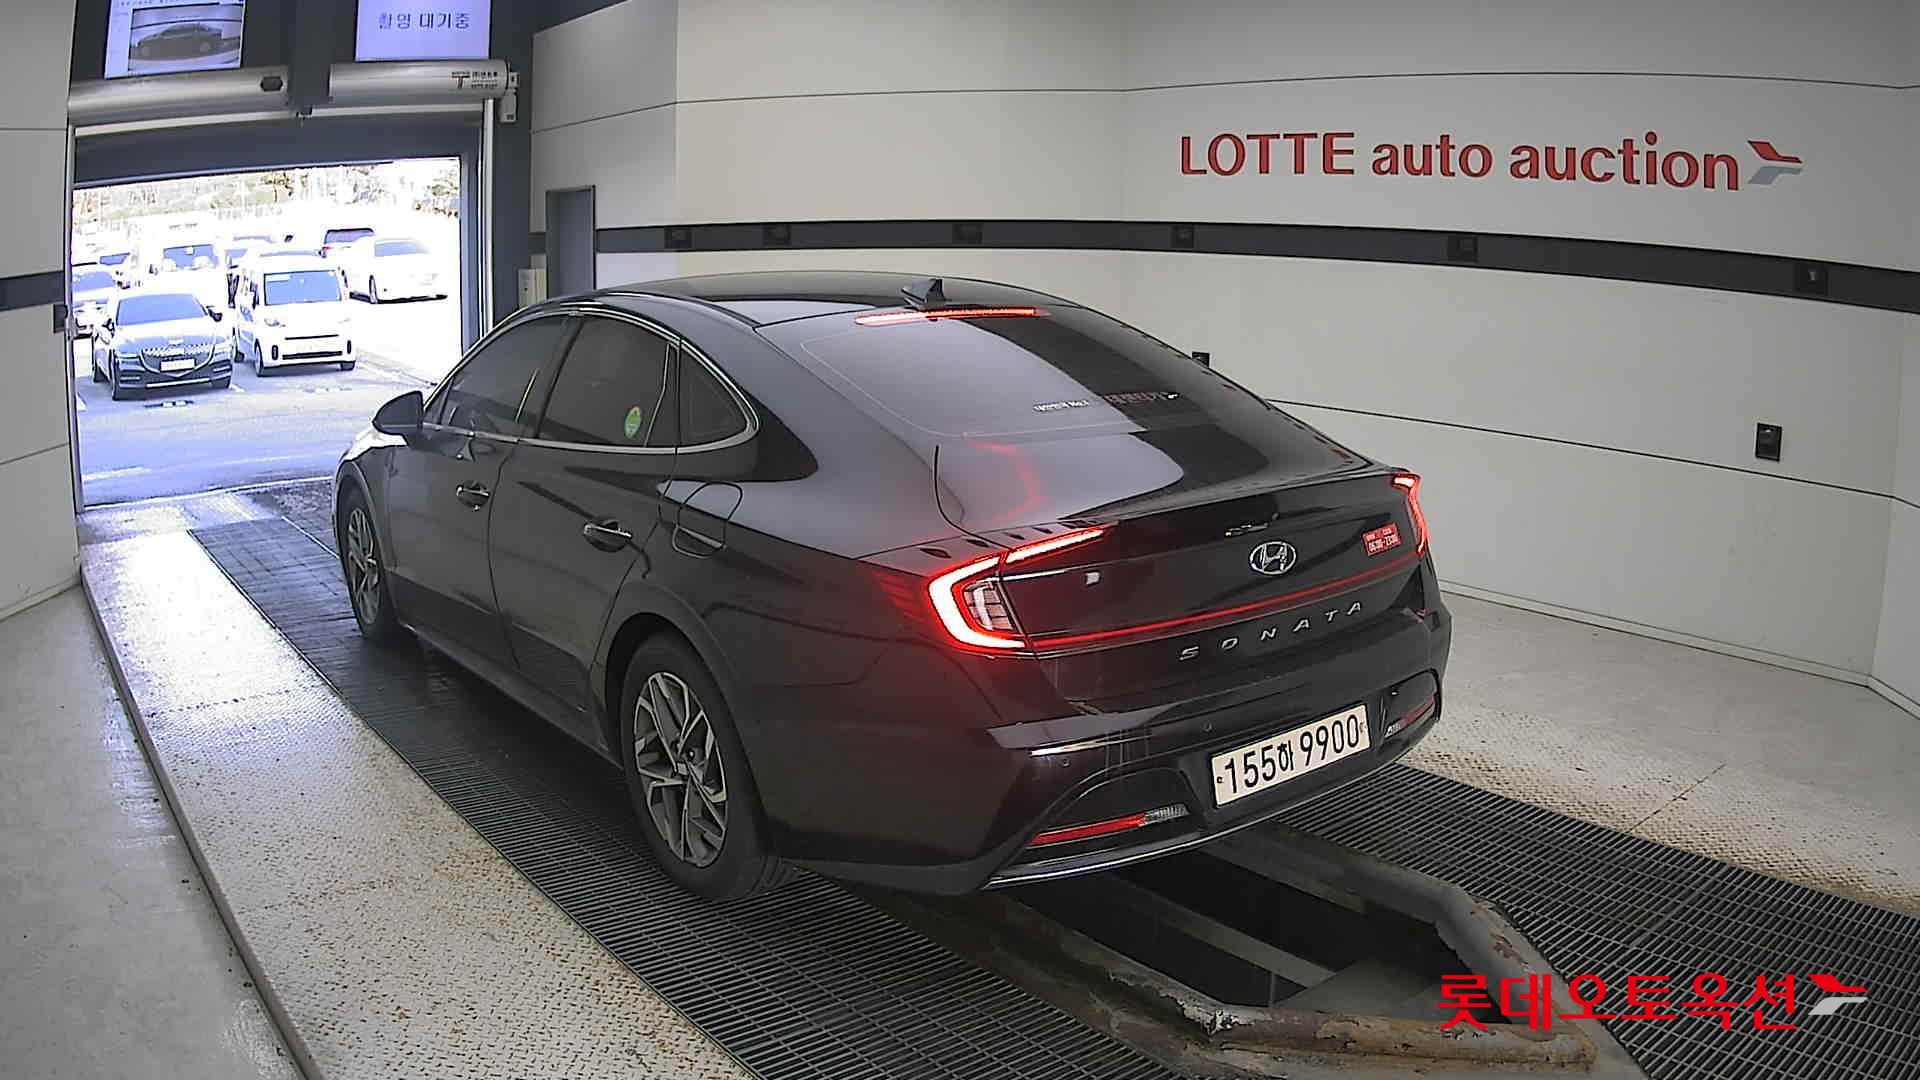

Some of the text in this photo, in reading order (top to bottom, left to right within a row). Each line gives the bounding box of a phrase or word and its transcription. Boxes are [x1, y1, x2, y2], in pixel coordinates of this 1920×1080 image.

[419, 12, 470, 30] 대기중
[1180, 131, 1740, 191] LOTTE auto auction
[1179, 602, 1361, 660] SONATA
[1225, 714, 1359, 793] 155하 9900
